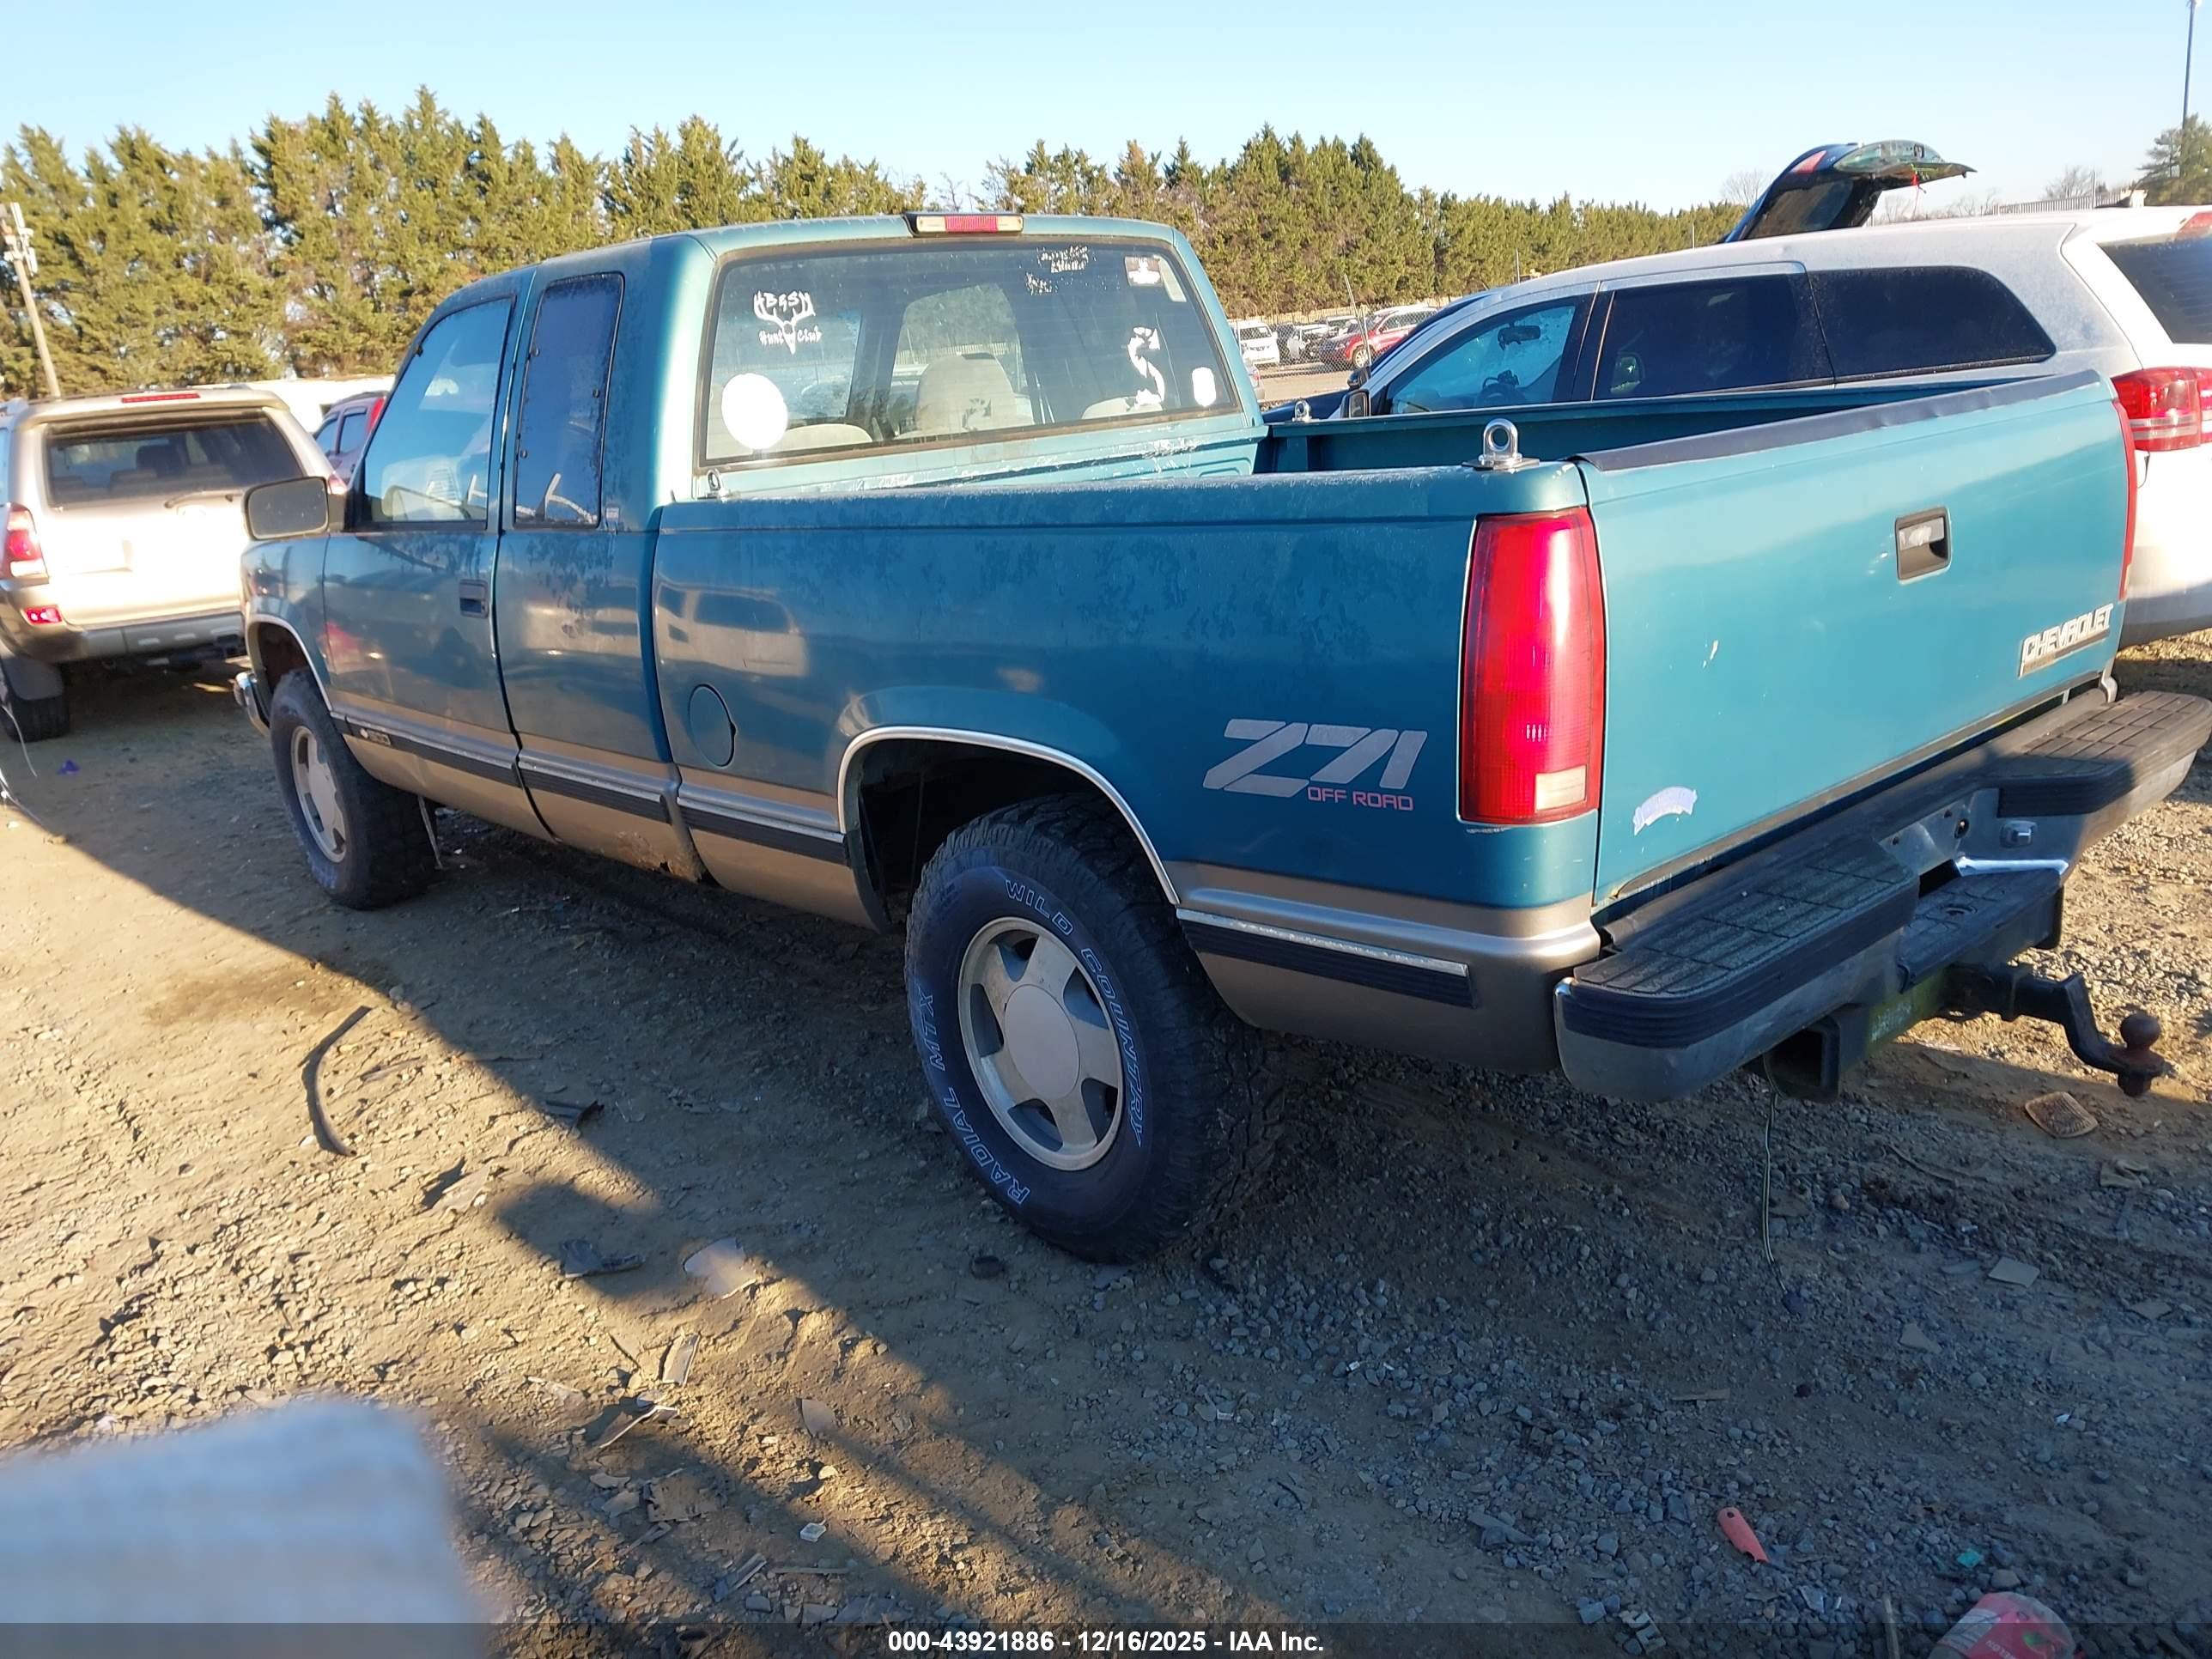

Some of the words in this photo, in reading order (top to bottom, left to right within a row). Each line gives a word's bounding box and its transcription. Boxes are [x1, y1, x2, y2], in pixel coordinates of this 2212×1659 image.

[2023, 603, 2114, 663] CHEVROLET
[1202, 718, 1428, 798] Z71
[1307, 786, 1346, 804] OFF
[1352, 791, 1413, 811] ROAD
[917, 984, 945, 1072] MTX
[1005, 880, 1074, 937] WILD
[1081, 948, 1143, 1147] COUNTRY
[944, 1086, 1031, 1204] RADIAL
